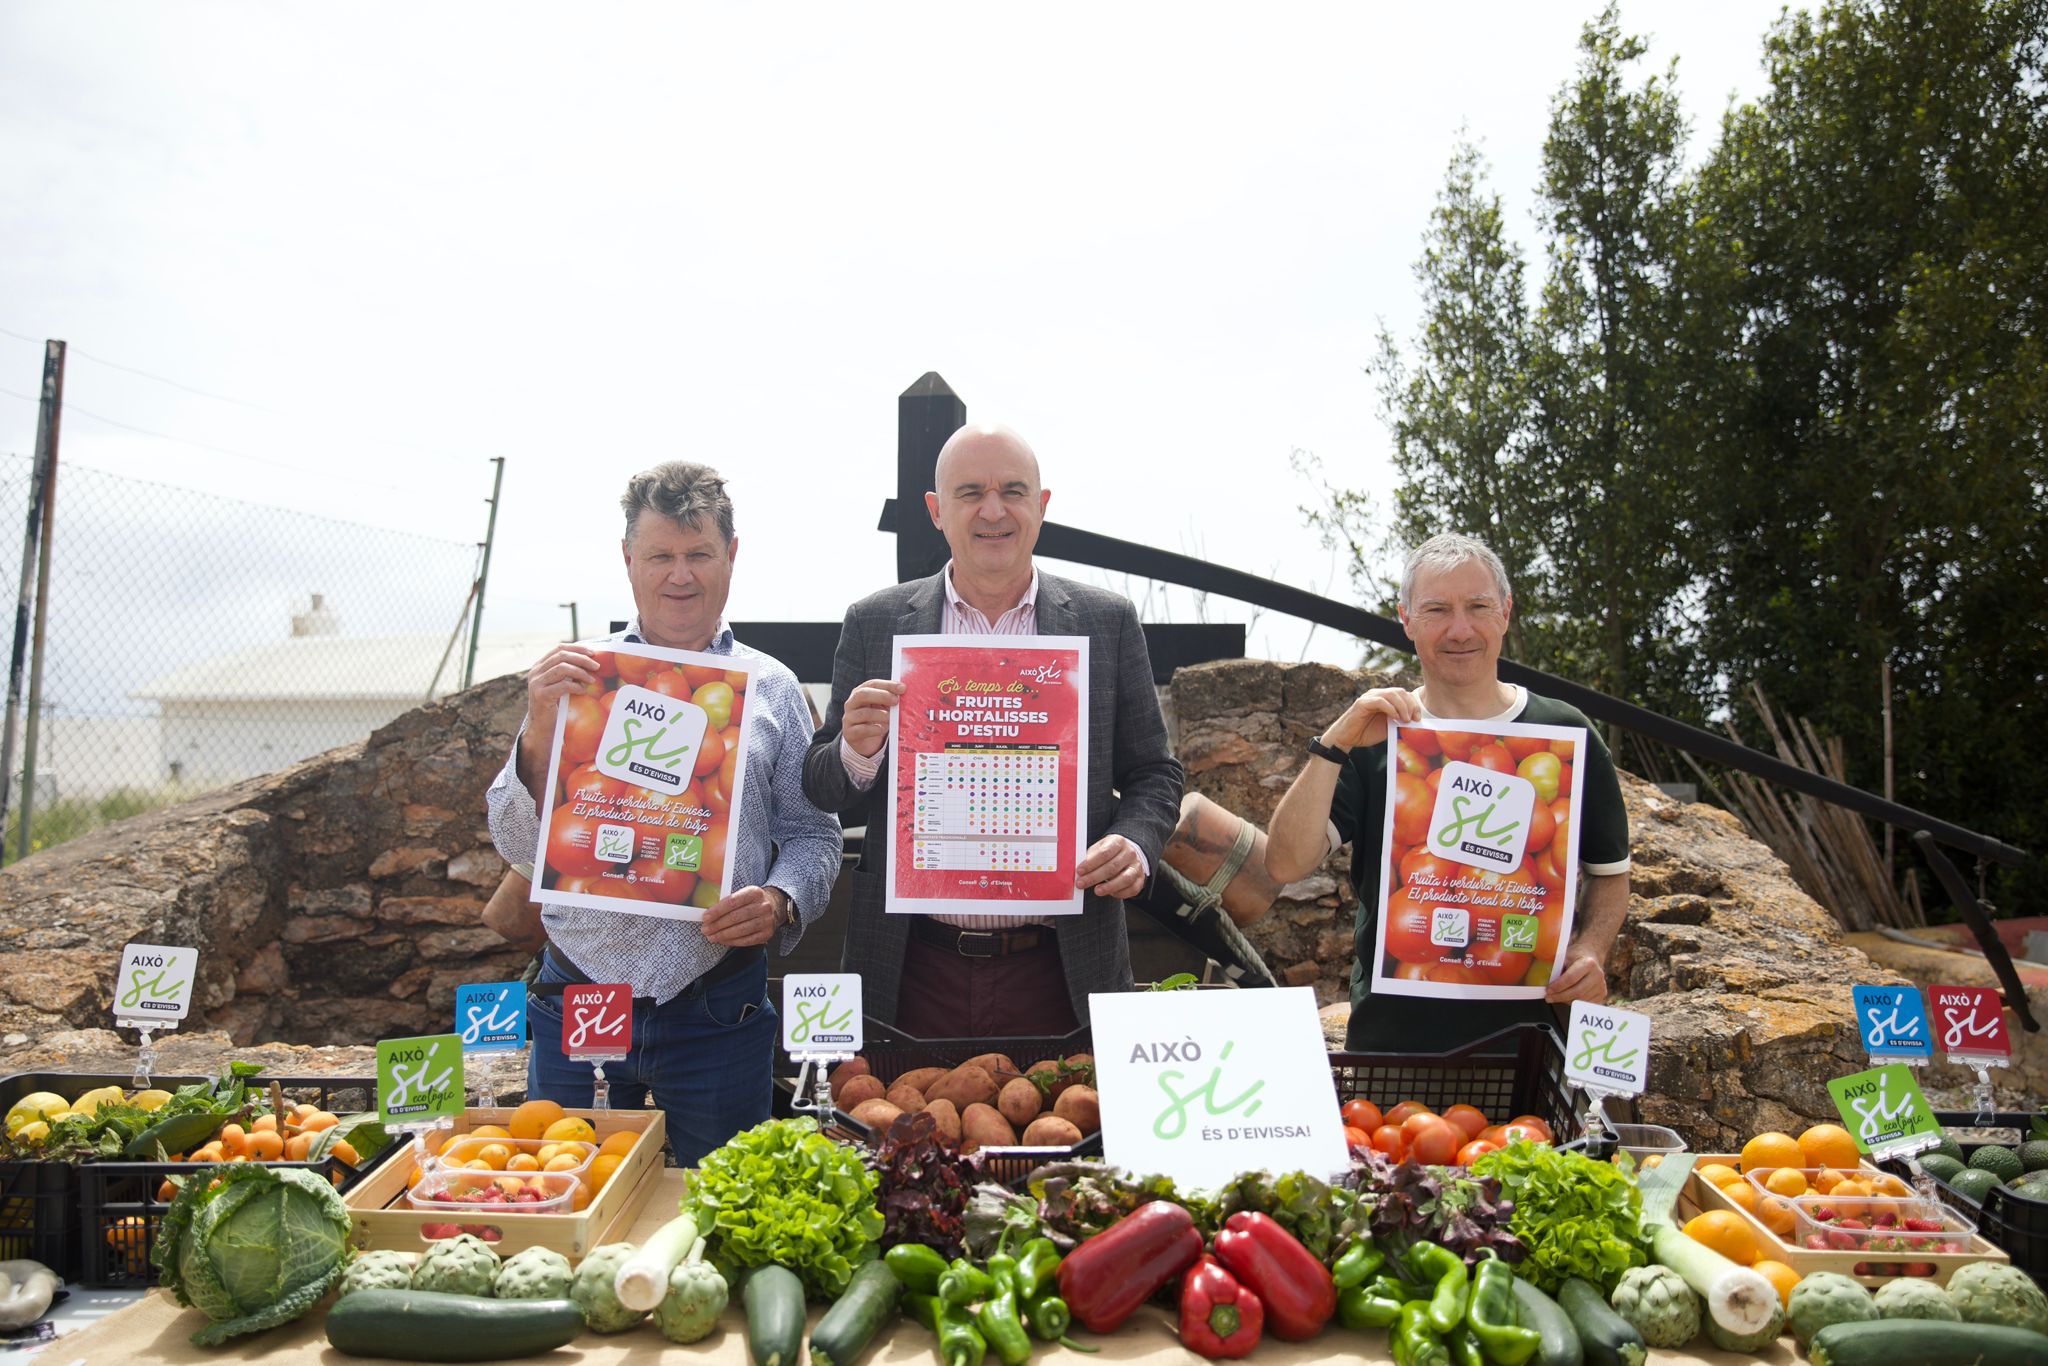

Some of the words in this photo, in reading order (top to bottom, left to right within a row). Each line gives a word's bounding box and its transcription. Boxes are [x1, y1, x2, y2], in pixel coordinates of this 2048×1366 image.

[938, 676, 961, 694] És
[965, 680, 1003, 694] temps
[624, 698, 666, 722] AIXÒ
[956, 696, 1022, 708] FRUITES
[929, 710, 934, 720] I
[938, 710, 1048, 724] HORTALISSES
[958, 724, 1019, 736] D'ESTIU
[633, 764, 642, 774] ÉS
[644, 766, 676, 784] D'EIVISSA
[1452, 776, 1493, 796] AIXÒ
[574, 788, 607, 804] Fruita
[608, 794, 614, 804] i
[616, 794, 660, 812] verdura
[662, 800, 712, 818] d'Eivissa
[572, 803, 584, 816] El
[584, 806, 636, 823] producto
[637, 812, 664, 827] local
[666, 816, 680, 828] de
[682, 818, 709, 836] Ibiza
[1464, 843, 1475, 854] ÉS
[1476, 846, 1509, 862] D'EIVISSA
[1408, 872, 1441, 886] Fruita
[1442, 875, 1448, 886] i
[1450, 876, 1492, 891] verdura
[1494, 880, 1547, 896] d'Eivissa
[1408, 886, 1420, 900] El
[1420, 890, 1470, 906] producto
[1470, 892, 1498, 907] local
[1500, 897, 1514, 908] de
[1516, 898, 1545, 916] Ibiza
[131, 954, 163, 968] AIXÒ
[1440, 956, 1462, 964] Consell
[466, 989, 496, 1004] AIXÒ
[572, 990, 602, 1005] AIXÒ
[794, 984, 826, 998] AIXÒ
[1863, 992, 1892, 1006] AIXÒ
[1939, 993, 1970, 1006] AIXÒ
[1580, 1014, 1614, 1030] AIXÒ
[492, 1034, 517, 1042] D'EIVISSA
[388, 1046, 424, 1064] AIXÒ
[1129, 1035, 1202, 1064] AIXÒ
[1606, 1070, 1634, 1082] D'EIVISSA
[412, 1085, 454, 1110] ecològic
[1844, 1080, 1877, 1100] AIXÒ
[400, 1104, 428, 1113] D'EIVISSA
[1884, 1112, 1924, 1134] ecològic
[1202, 1125, 1223, 1141] ÉS
[1228, 1125, 1311, 1140] D'EIVISSA!
[1875, 1132, 1902, 1142] D'EIVISSA
